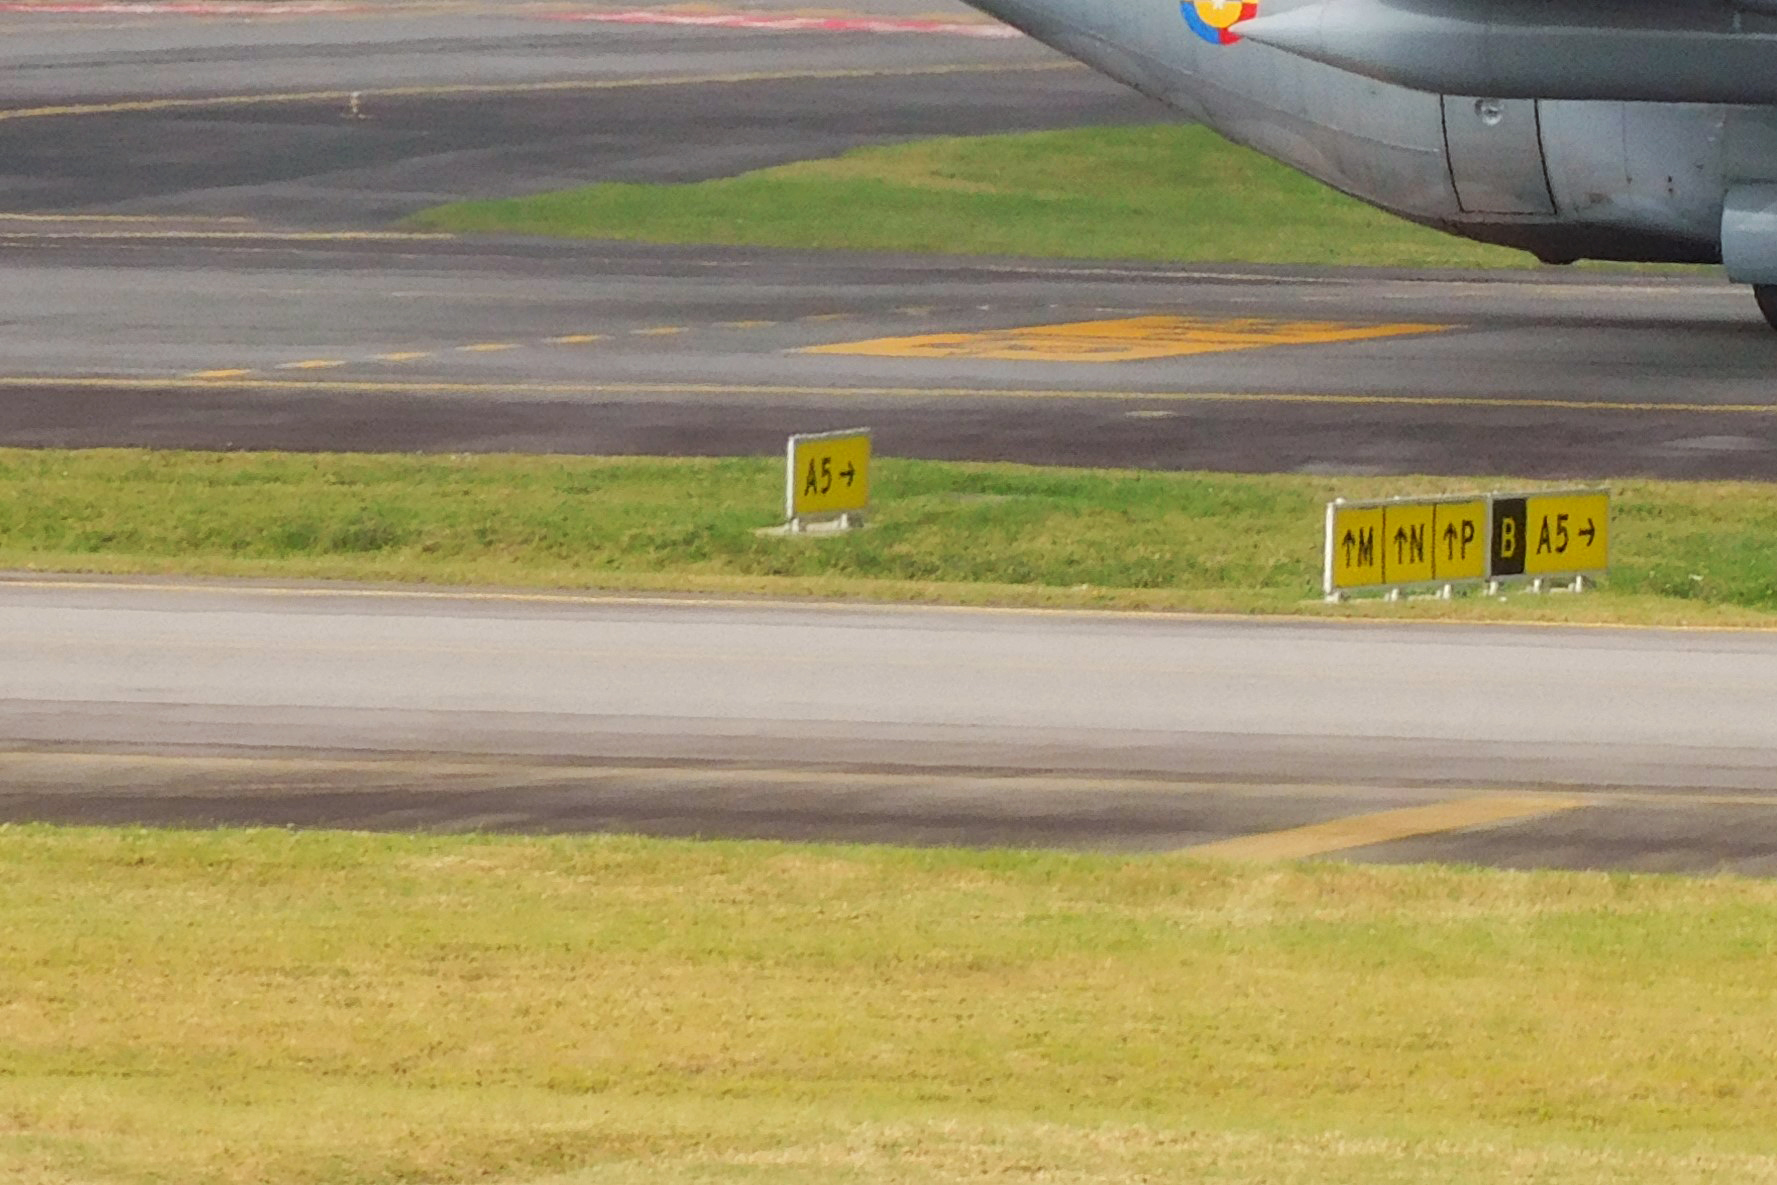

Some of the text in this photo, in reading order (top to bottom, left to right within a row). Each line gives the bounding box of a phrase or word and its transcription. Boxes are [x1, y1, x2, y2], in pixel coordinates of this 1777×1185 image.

[803, 456, 833, 497] A5
[1357, 513, 1570, 567] M N P B A5
